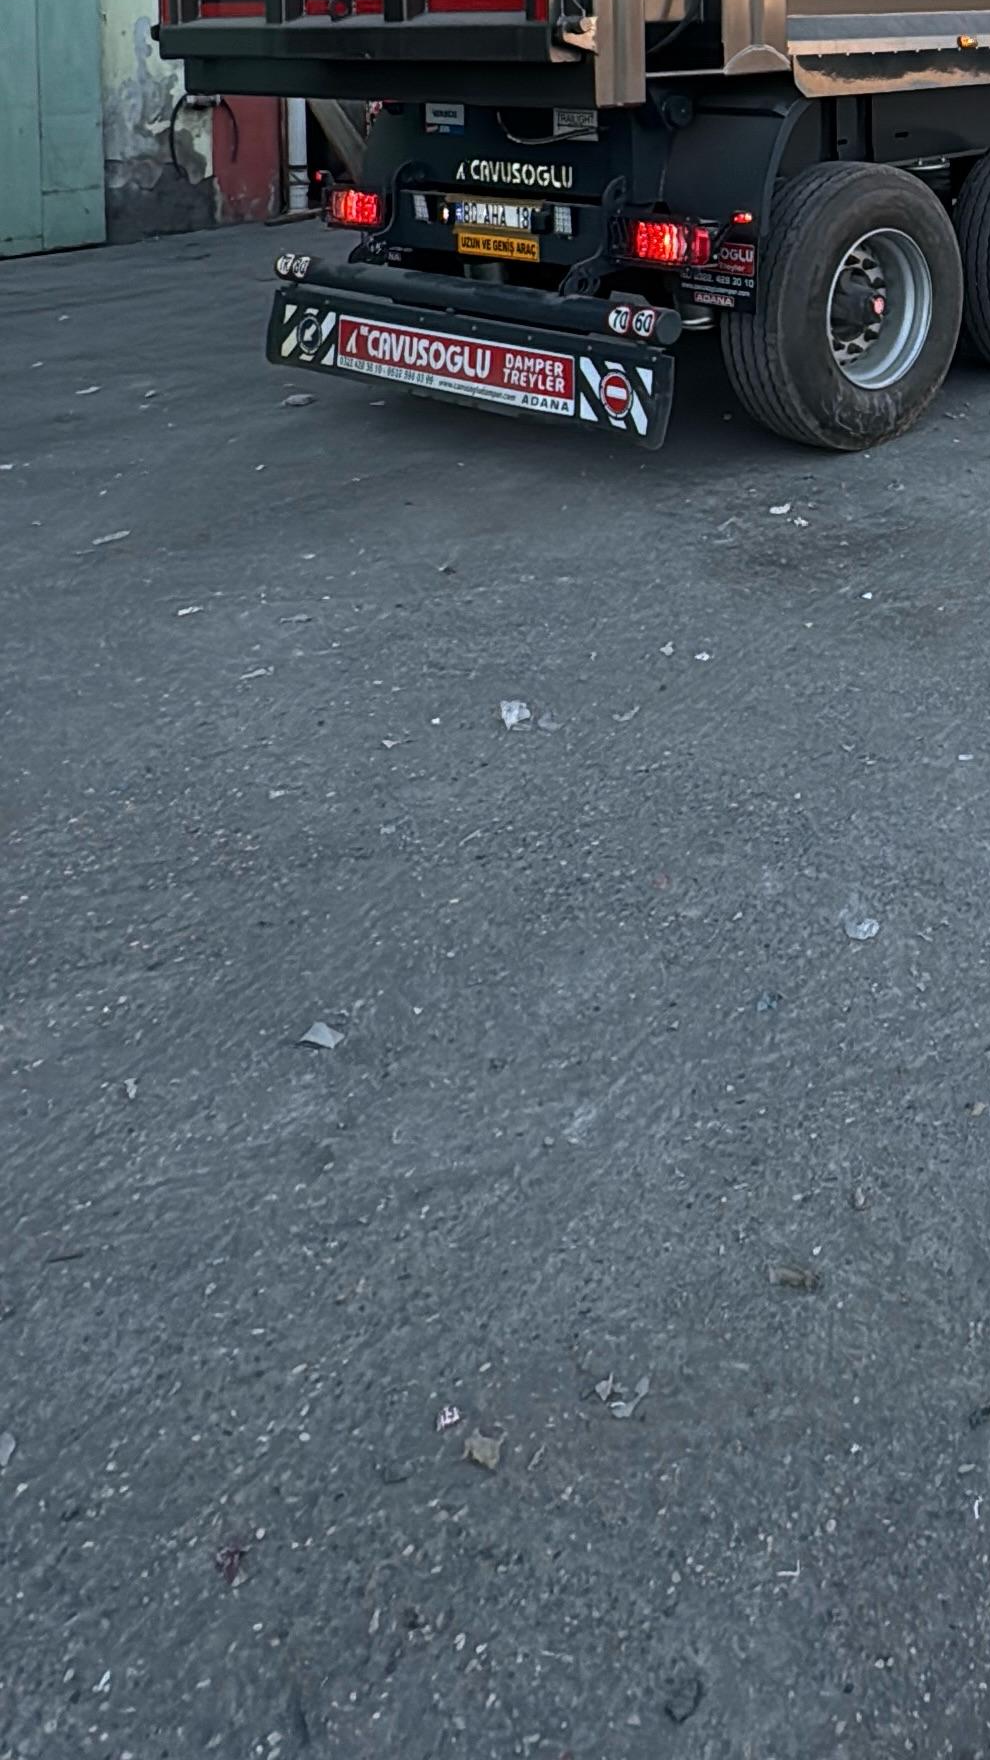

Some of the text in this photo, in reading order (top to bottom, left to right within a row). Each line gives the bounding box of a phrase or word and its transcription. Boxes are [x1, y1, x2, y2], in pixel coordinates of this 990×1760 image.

[470, 159, 573, 189] CAVUSOGLU
[461, 236, 481, 249] UZUN
[482, 238, 492, 250] VE
[614, 309, 629, 330] 70
[634, 312, 653, 333] 60
[367, 329, 491, 379] CAVUSOGLU
[505, 353, 564, 378] DAMPER
[502, 368, 565, 393] TREYLER
[521, 394, 570, 413] ADANA
